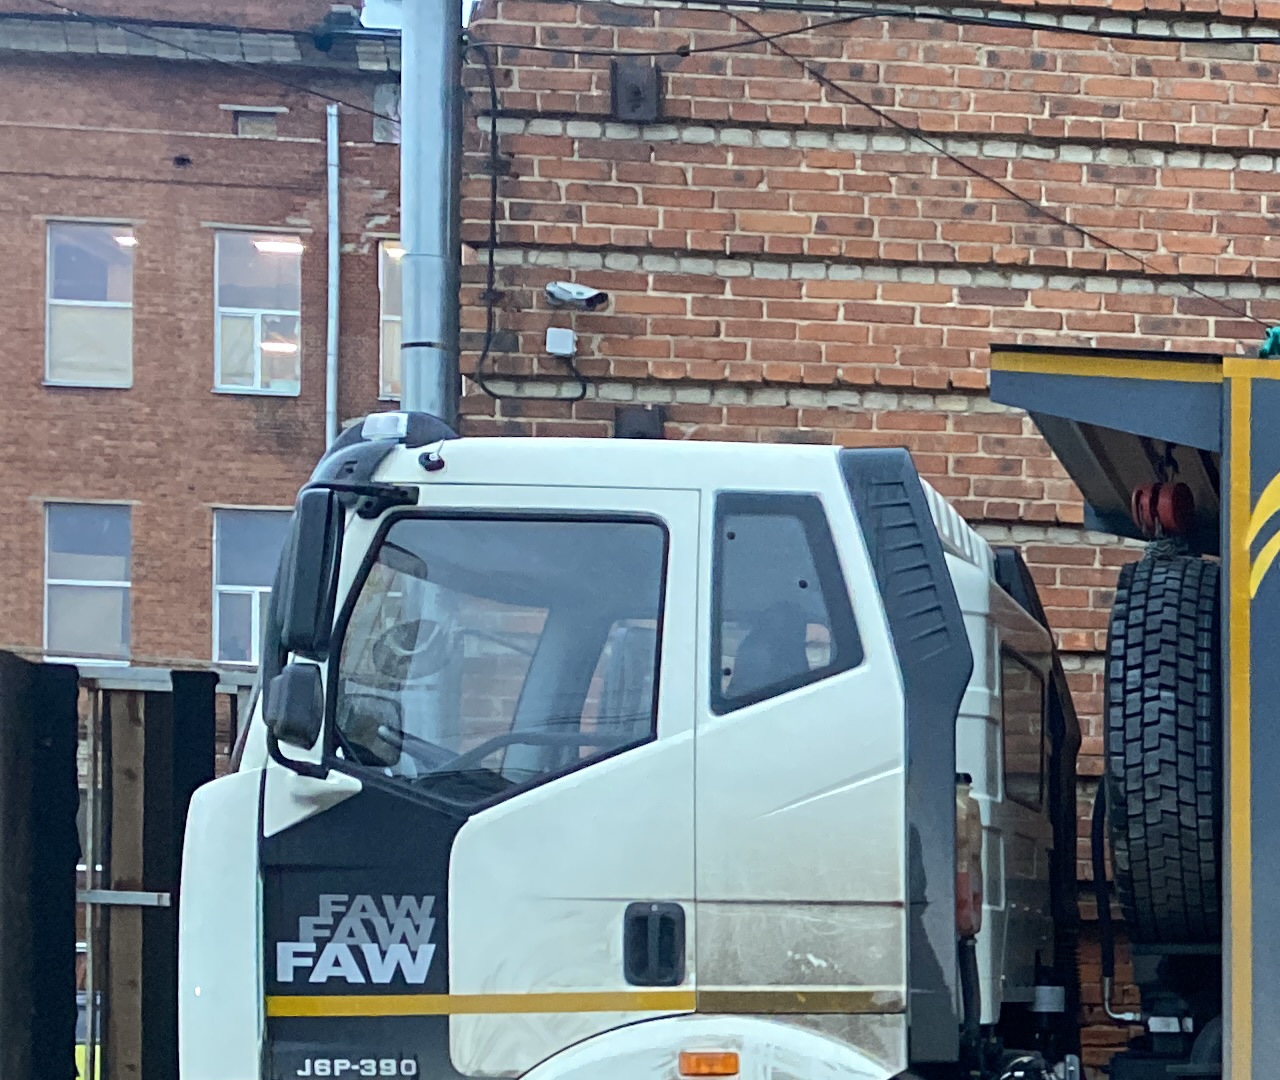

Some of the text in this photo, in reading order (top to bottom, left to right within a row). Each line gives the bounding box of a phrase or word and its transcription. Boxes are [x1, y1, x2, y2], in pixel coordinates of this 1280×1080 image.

[318, 893, 436, 923] FAW
[276, 942, 436, 984] FAW
[296, 1058, 418, 1077] J6P-390
